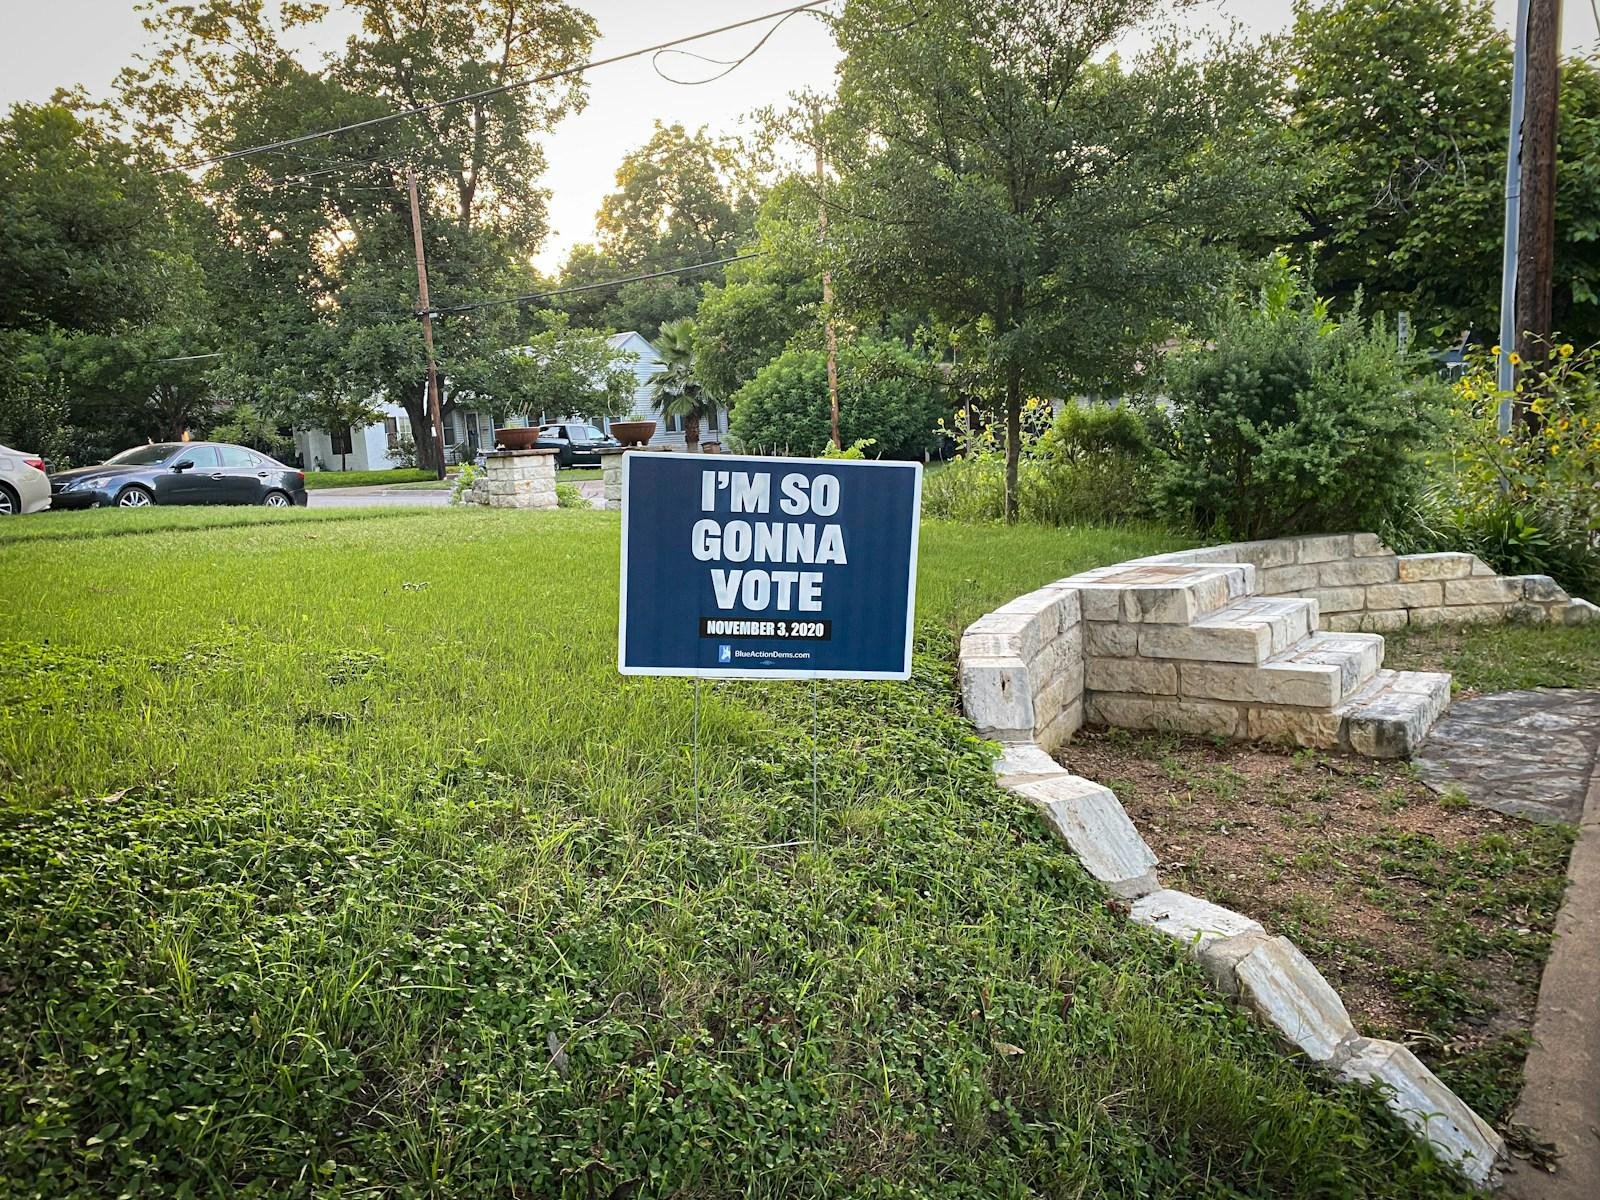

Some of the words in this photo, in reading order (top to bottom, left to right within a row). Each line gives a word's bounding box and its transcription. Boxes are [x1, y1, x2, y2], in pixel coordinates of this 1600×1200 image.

[701, 471, 771, 514] I'M
[780, 473, 840, 517] SO
[692, 519, 847, 565] GONNA
[711, 569, 824, 612] VOTE
[707, 620, 774, 636] NOVEMBER
[777, 622, 789, 637] 3,
[791, 622, 825, 637] 2020
[734, 650, 811, 660] BlueActionDems.com
